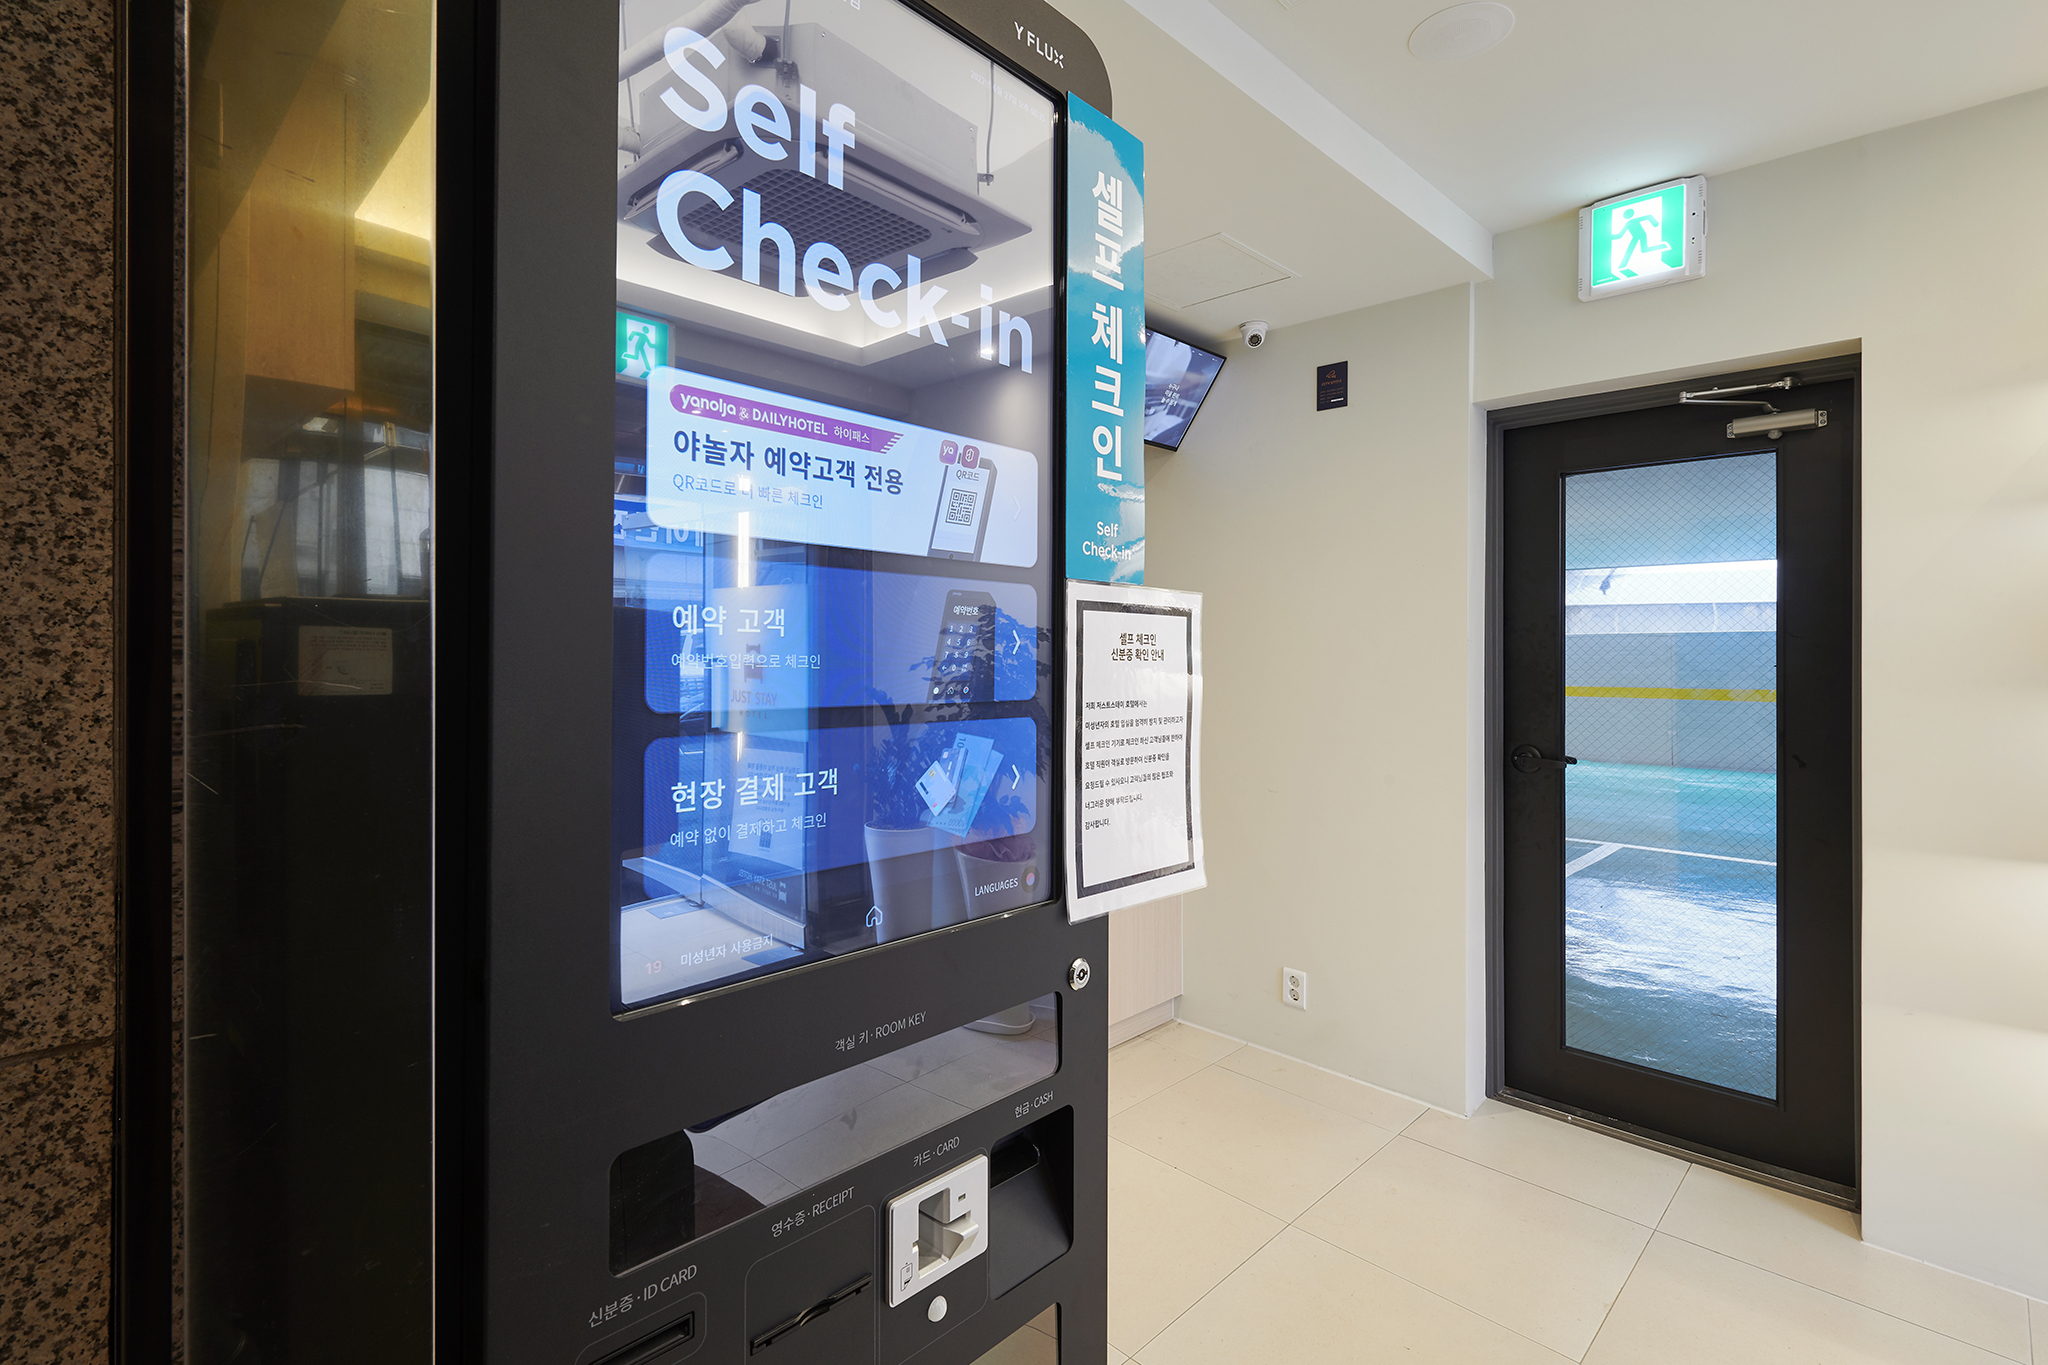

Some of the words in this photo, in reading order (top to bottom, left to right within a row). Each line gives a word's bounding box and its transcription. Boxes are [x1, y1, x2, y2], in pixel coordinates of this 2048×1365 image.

[1014, 21, 1024, 40] Y
[1027, 30, 1064, 69] FLUX
[660, 26, 856, 190] Self
[1092, 171, 1124, 291] 셀프
[655, 169, 1033, 375] Check-in
[1091, 302, 1124, 481] 체크인
[681, 393, 736, 417] yanolja
[753, 408, 828, 436] DAILYHOTEL
[834, 426, 870, 444] 하이패스
[674, 429, 755, 471] 야놀자
[764, 446, 856, 488] 예약고객
[864, 464, 904, 496] 전용
[956, 470, 980, 481] QR코드
[673, 473, 736, 497] QR코드로
[758, 486, 784, 504] 빠른
[788, 490, 824, 510] 체크인
[1097, 521, 1118, 537] Self
[1083, 541, 1131, 560] Check-in
[672, 604, 727, 636] 예약
[737, 606, 785, 637] 고객
[953, 605, 980, 616] 예약번호
[1111, 648, 1133, 662] 신분증
[1135, 648, 1149, 662] 확인
[1151, 649, 1165, 662] 안내
[1120, 633, 1134, 646] 셀프
[1136, 633, 1157, 647] 체크인
[672, 653, 781, 670] 예약번호입력으로
[785, 654, 821, 670] 체크인
[731, 690, 752, 703] JUST
[755, 693, 777, 706] STAY
[671, 781, 726, 814] 현장
[737, 773, 784, 806] 결제
[794, 768, 839, 798] 고객
[670, 829, 699, 849] 예약
[704, 826, 731, 845] 없이
[737, 819, 787, 840] 결제하고
[791, 813, 827, 831] 체크인
[974, 877, 1018, 896] LANGUAGES
[681, 945, 727, 967] 미성년자
[731, 934, 773, 955] 사용금지
[645, 960, 663, 975] 19
[835, 1035, 855, 1052] 객실
[909, 1011, 927, 1027] KEY
[661, 1265, 698, 1292] CARD
